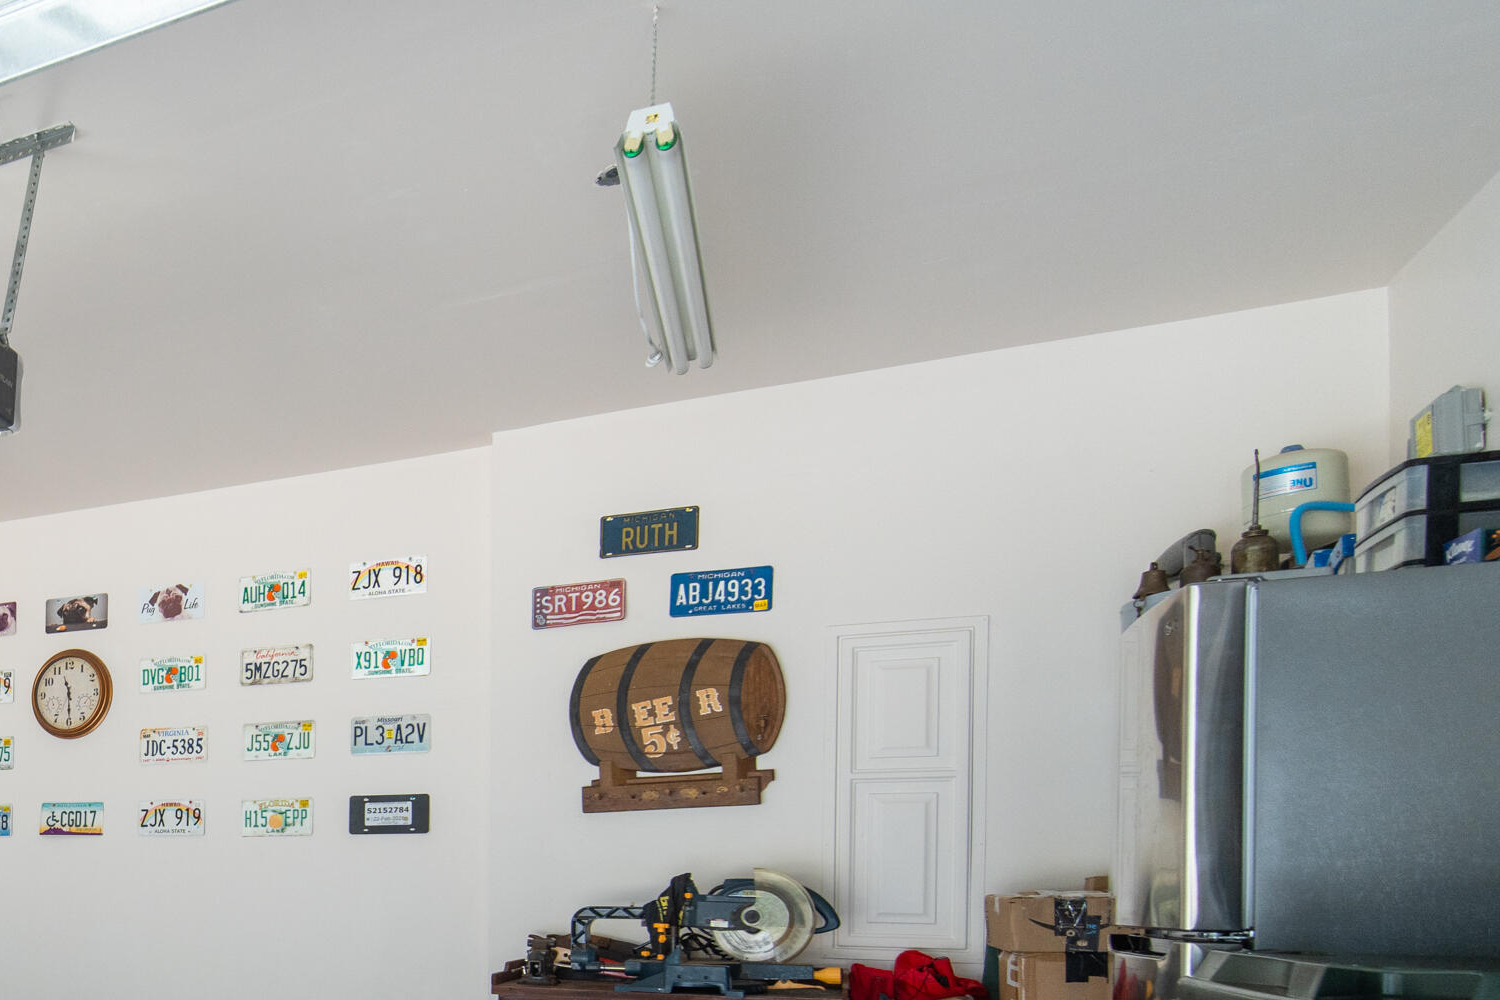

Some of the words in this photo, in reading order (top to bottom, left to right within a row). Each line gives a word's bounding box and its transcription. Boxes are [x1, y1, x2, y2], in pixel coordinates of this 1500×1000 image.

[623, 512, 676, 523] MICHIGAN
[621, 521, 678, 550] RUTH
[352, 568, 381, 591] ZJX
[393, 564, 423, 586] 918
[697, 571, 745, 580] MICHIGAN
[242, 586, 266, 605] AUH
[555, 583, 601, 593] MICHIGAN
[675, 578, 766, 606] ABJ4933
[141, 602, 156, 616] Pug
[183, 597, 199, 611] Life
[541, 588, 621, 614] SRT986
[65, 661, 74, 670] 12
[355, 650, 380, 670] X91
[53, 667, 61, 675] 11
[89, 673, 95, 682] 2
[142, 668, 165, 686] DVG
[245, 658, 308, 680] 5MZG275
[45, 677, 54, 687] 10
[40, 692, 46, 700] 9
[93, 688, 98, 697] 3
[54, 713, 59, 723] 7
[66, 718, 72, 726] 6
[79, 712, 86, 721] 5
[157, 729, 190, 738] VIRGINIA
[246, 734, 270, 752] J55
[287, 732, 310, 750] ZJU
[353, 725, 385, 746] PL3
[394, 722, 426, 744] A2V
[641, 724, 681, 758] 5¢
[144, 738, 203, 758] JDC-5385
[258, 800, 296, 810] FLORIDA
[367, 806, 409, 814] S2152784
[60, 810, 97, 827] CGD17
[140, 809, 165, 828] ZJX
[175, 807, 201, 827] 919
[245, 809, 268, 828] H15
[284, 809, 308, 827] EPP
